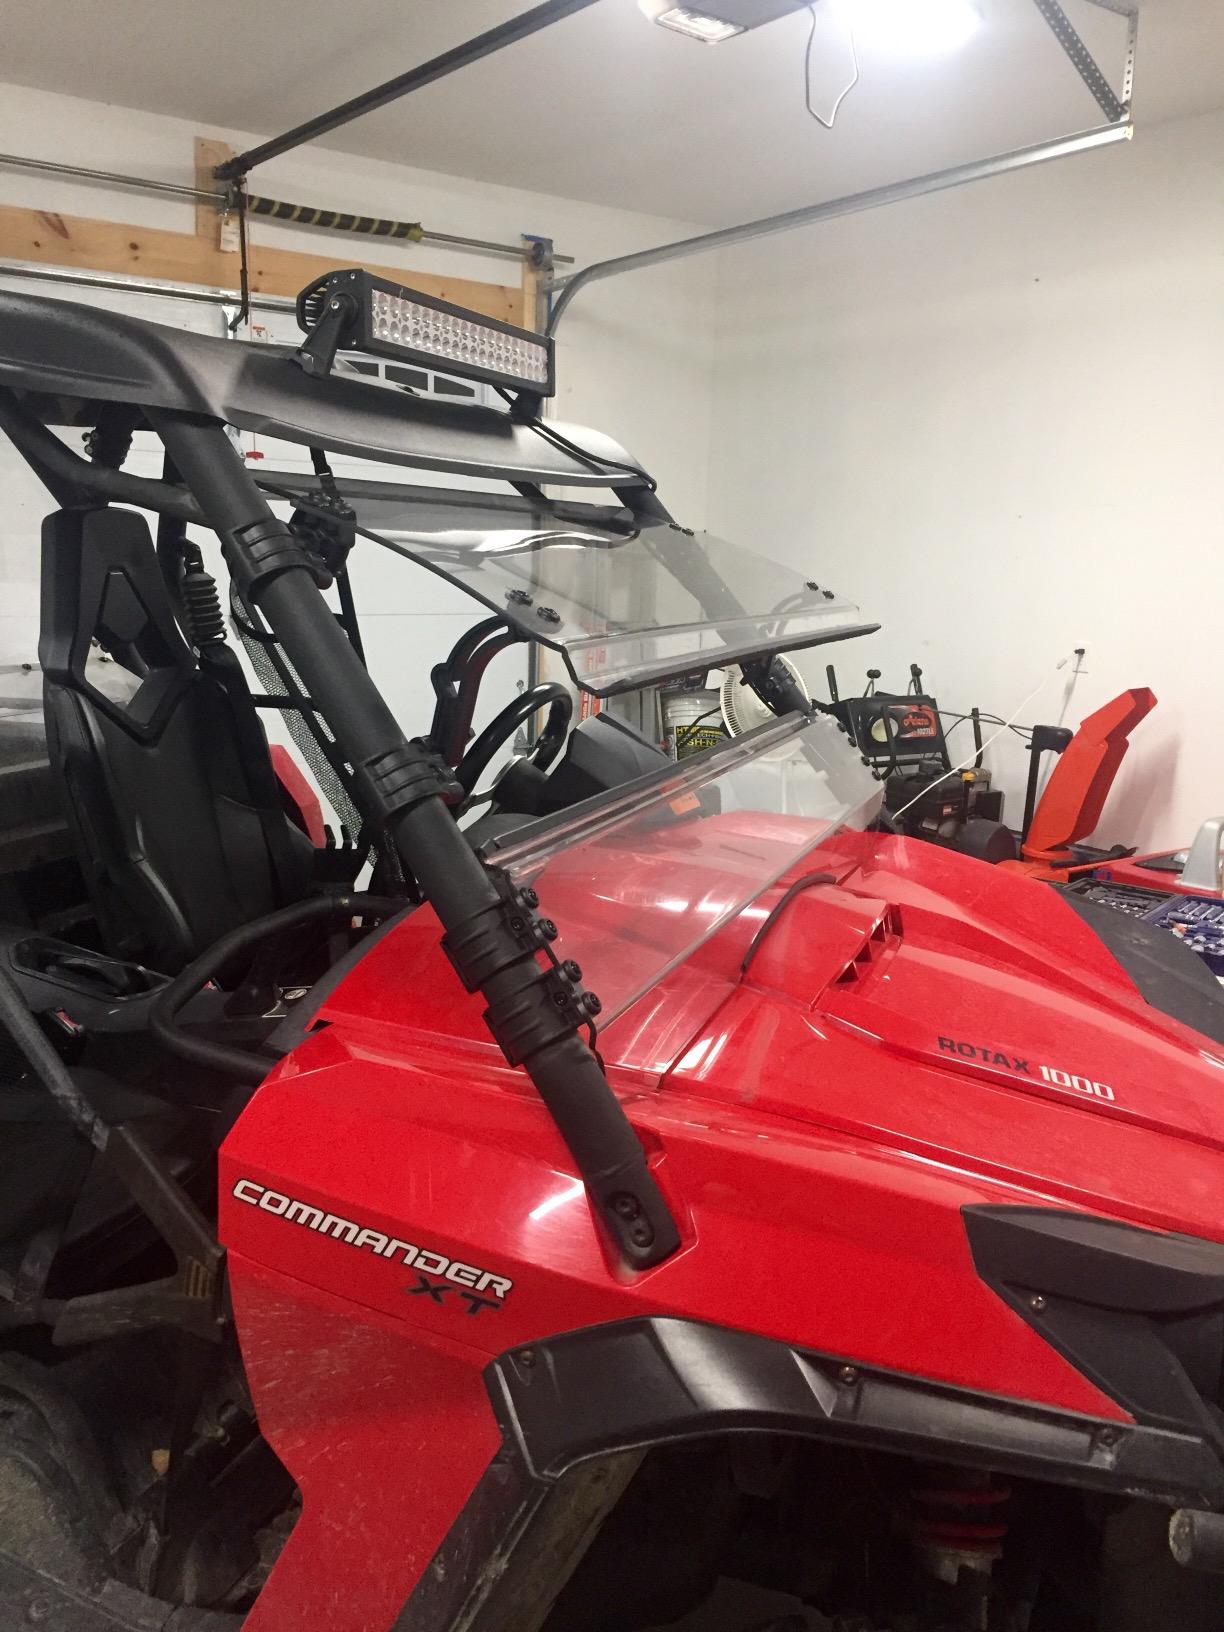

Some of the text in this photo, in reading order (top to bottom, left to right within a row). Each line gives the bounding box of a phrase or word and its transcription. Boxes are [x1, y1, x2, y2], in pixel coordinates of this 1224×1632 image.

[938, 1036, 1115, 1101] ROTAX 1000
[231, 1177, 514, 1299] COMMANDER
[408, 1276, 500, 1314] XT
